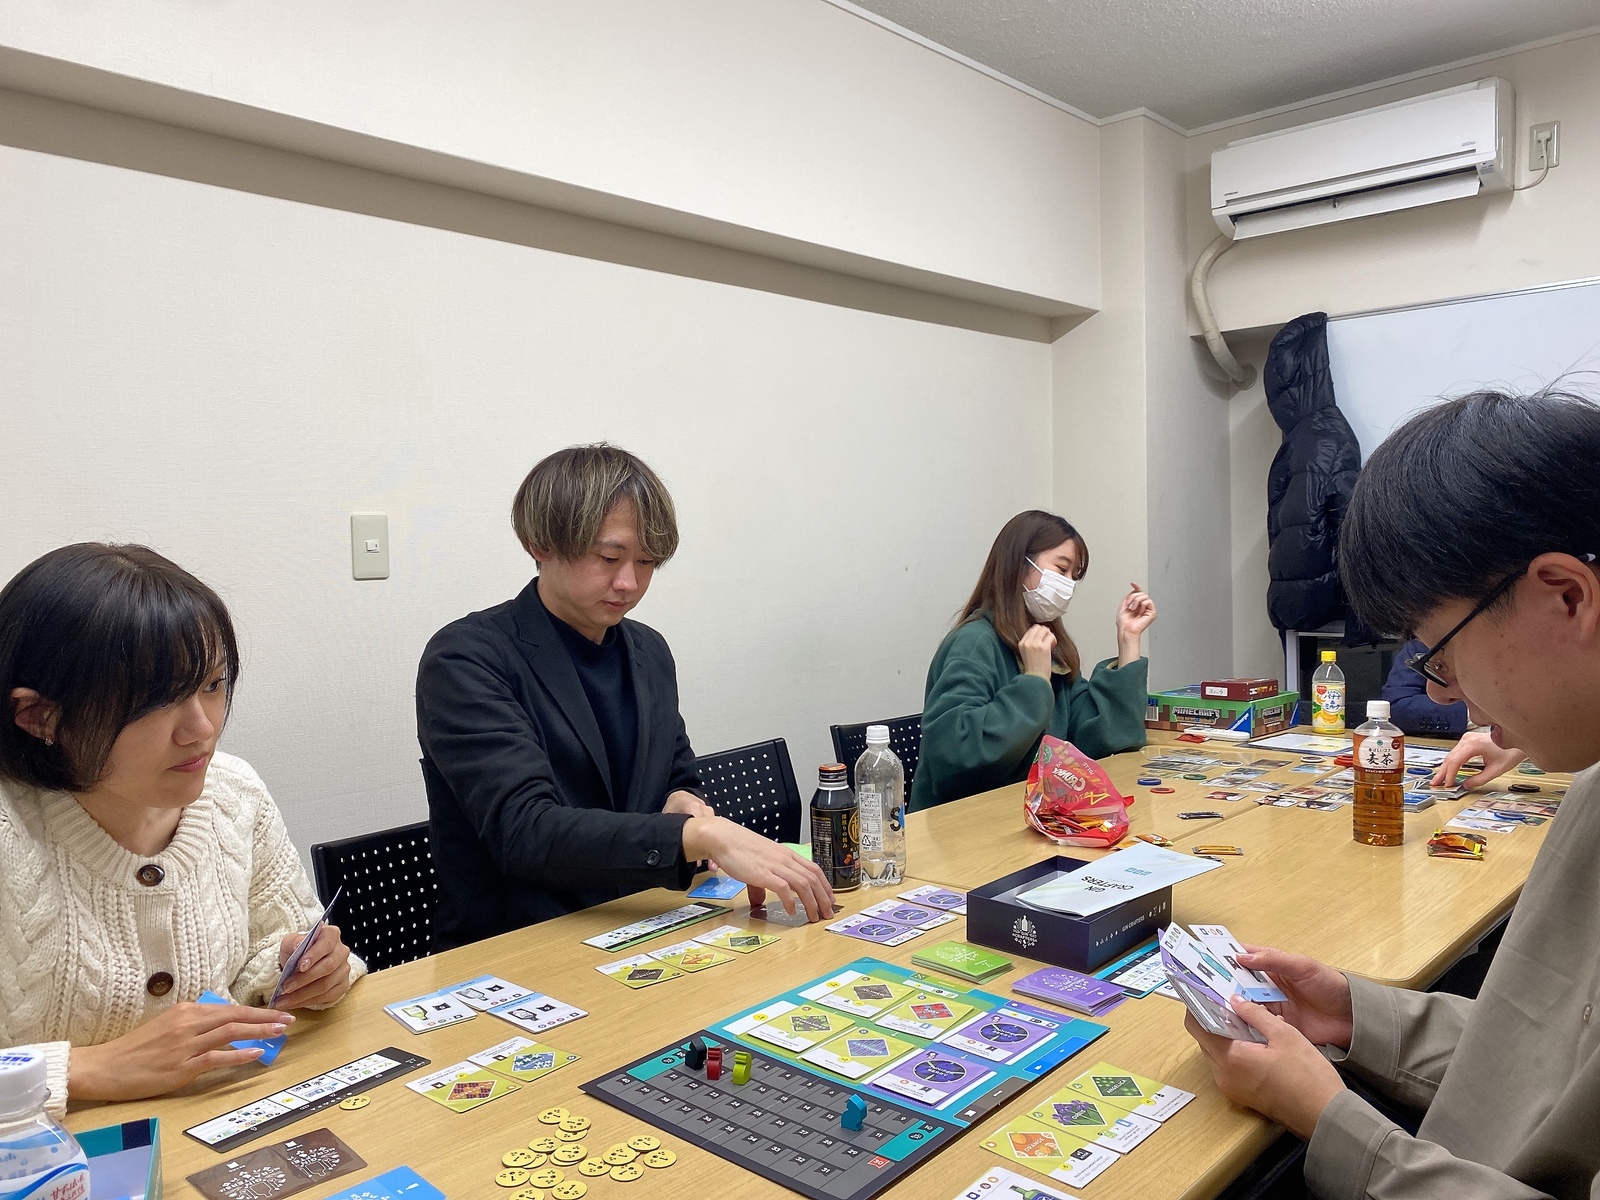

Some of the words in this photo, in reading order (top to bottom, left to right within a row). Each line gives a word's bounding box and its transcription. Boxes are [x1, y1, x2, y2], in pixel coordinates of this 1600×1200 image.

[1174, 706, 1220, 718] MINECRAFT
[1366, 752, 1394, 766] 麦茶
[1081, 876, 1134, 890] CRAFTERS
[1024, 1137, 1046, 1152] ORANGE
